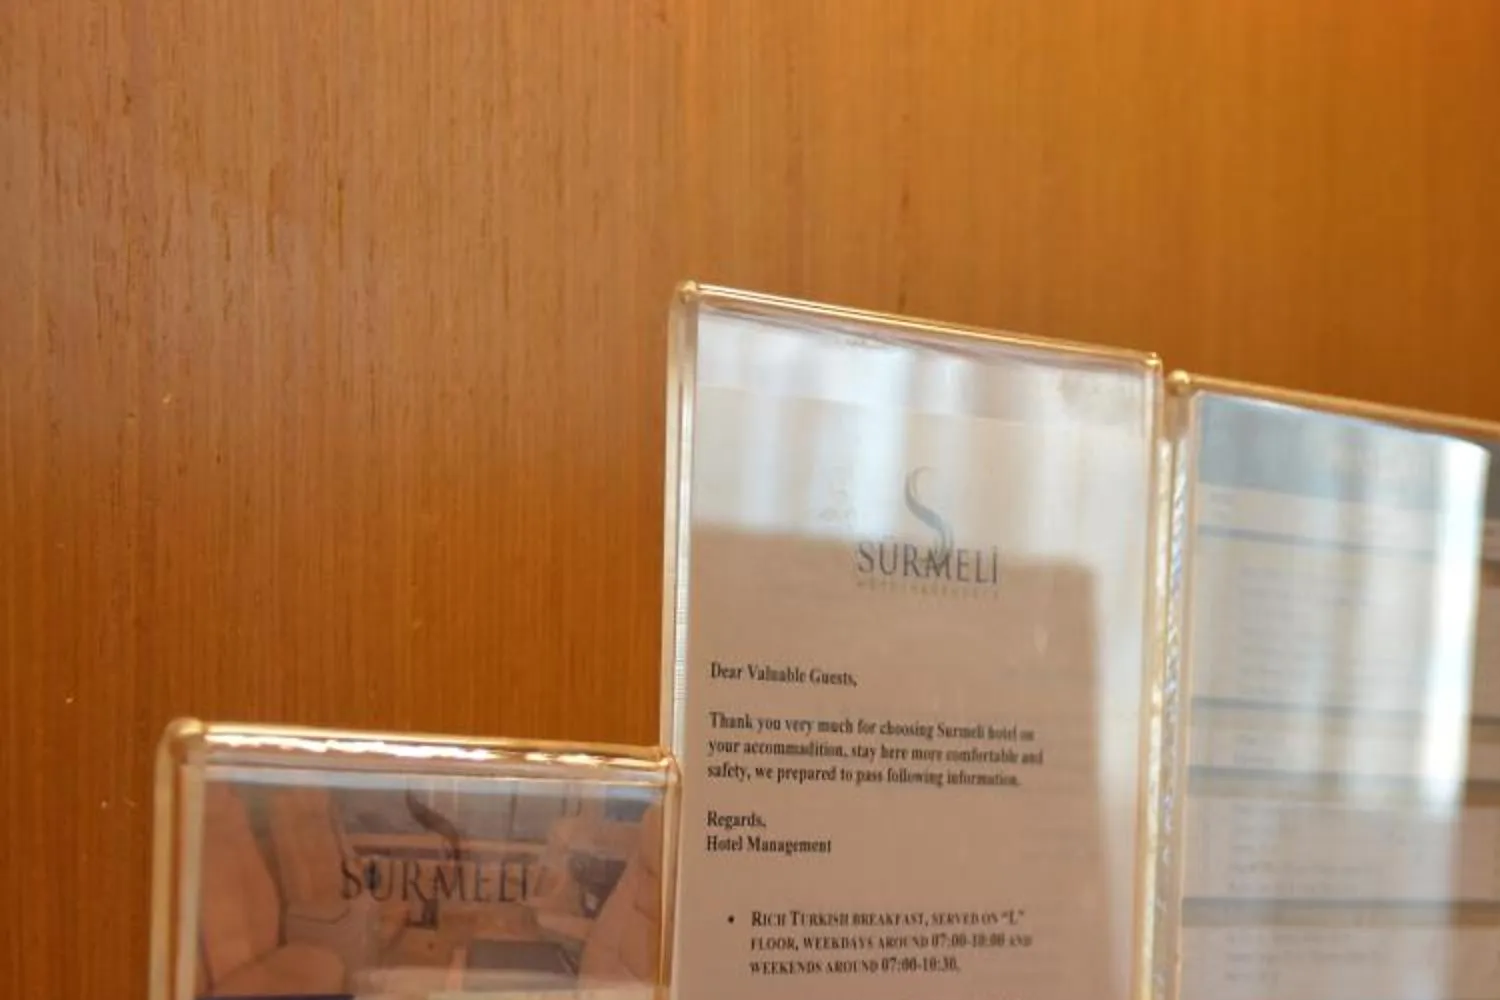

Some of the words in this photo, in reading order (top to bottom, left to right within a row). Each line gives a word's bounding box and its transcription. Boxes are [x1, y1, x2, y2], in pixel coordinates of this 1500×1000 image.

[711, 661, 743, 679] Dear
[747, 664, 806, 683] Valuable
[810, 668, 857, 687] Guests,
[709, 712, 752, 729] Thank
[757, 719, 781, 733] you
[785, 719, 812, 736] very
[817, 718, 853, 733] much
[858, 718, 876, 734] for
[879, 721, 934, 740] choosing
[987, 725, 1017, 741] hotel
[709, 740, 739, 756] your
[851, 743, 876, 762] stay
[880, 744, 907, 759] here
[911, 748, 943, 762] more
[946, 748, 1018, 763] comfortable
[1021, 750, 1043, 765] and
[708, 762, 750, 782] safety,
[755, 767, 773, 779] we
[777, 765, 836, 784] prepared
[840, 768, 852, 782] to
[856, 770, 883, 785] pass
[887, 768, 944, 788] following
[947, 770, 1021, 786] information.
[707, 810, 767, 829] Regards,
[707, 835, 743, 852] Hotel
[747, 836, 831, 855] Management
[803, 936, 874, 949] WEEKDAYS
[878, 935, 929, 949] AROUND
[750, 960, 822, 975] WEEKENDS
[826, 959, 879, 973] AROUND
